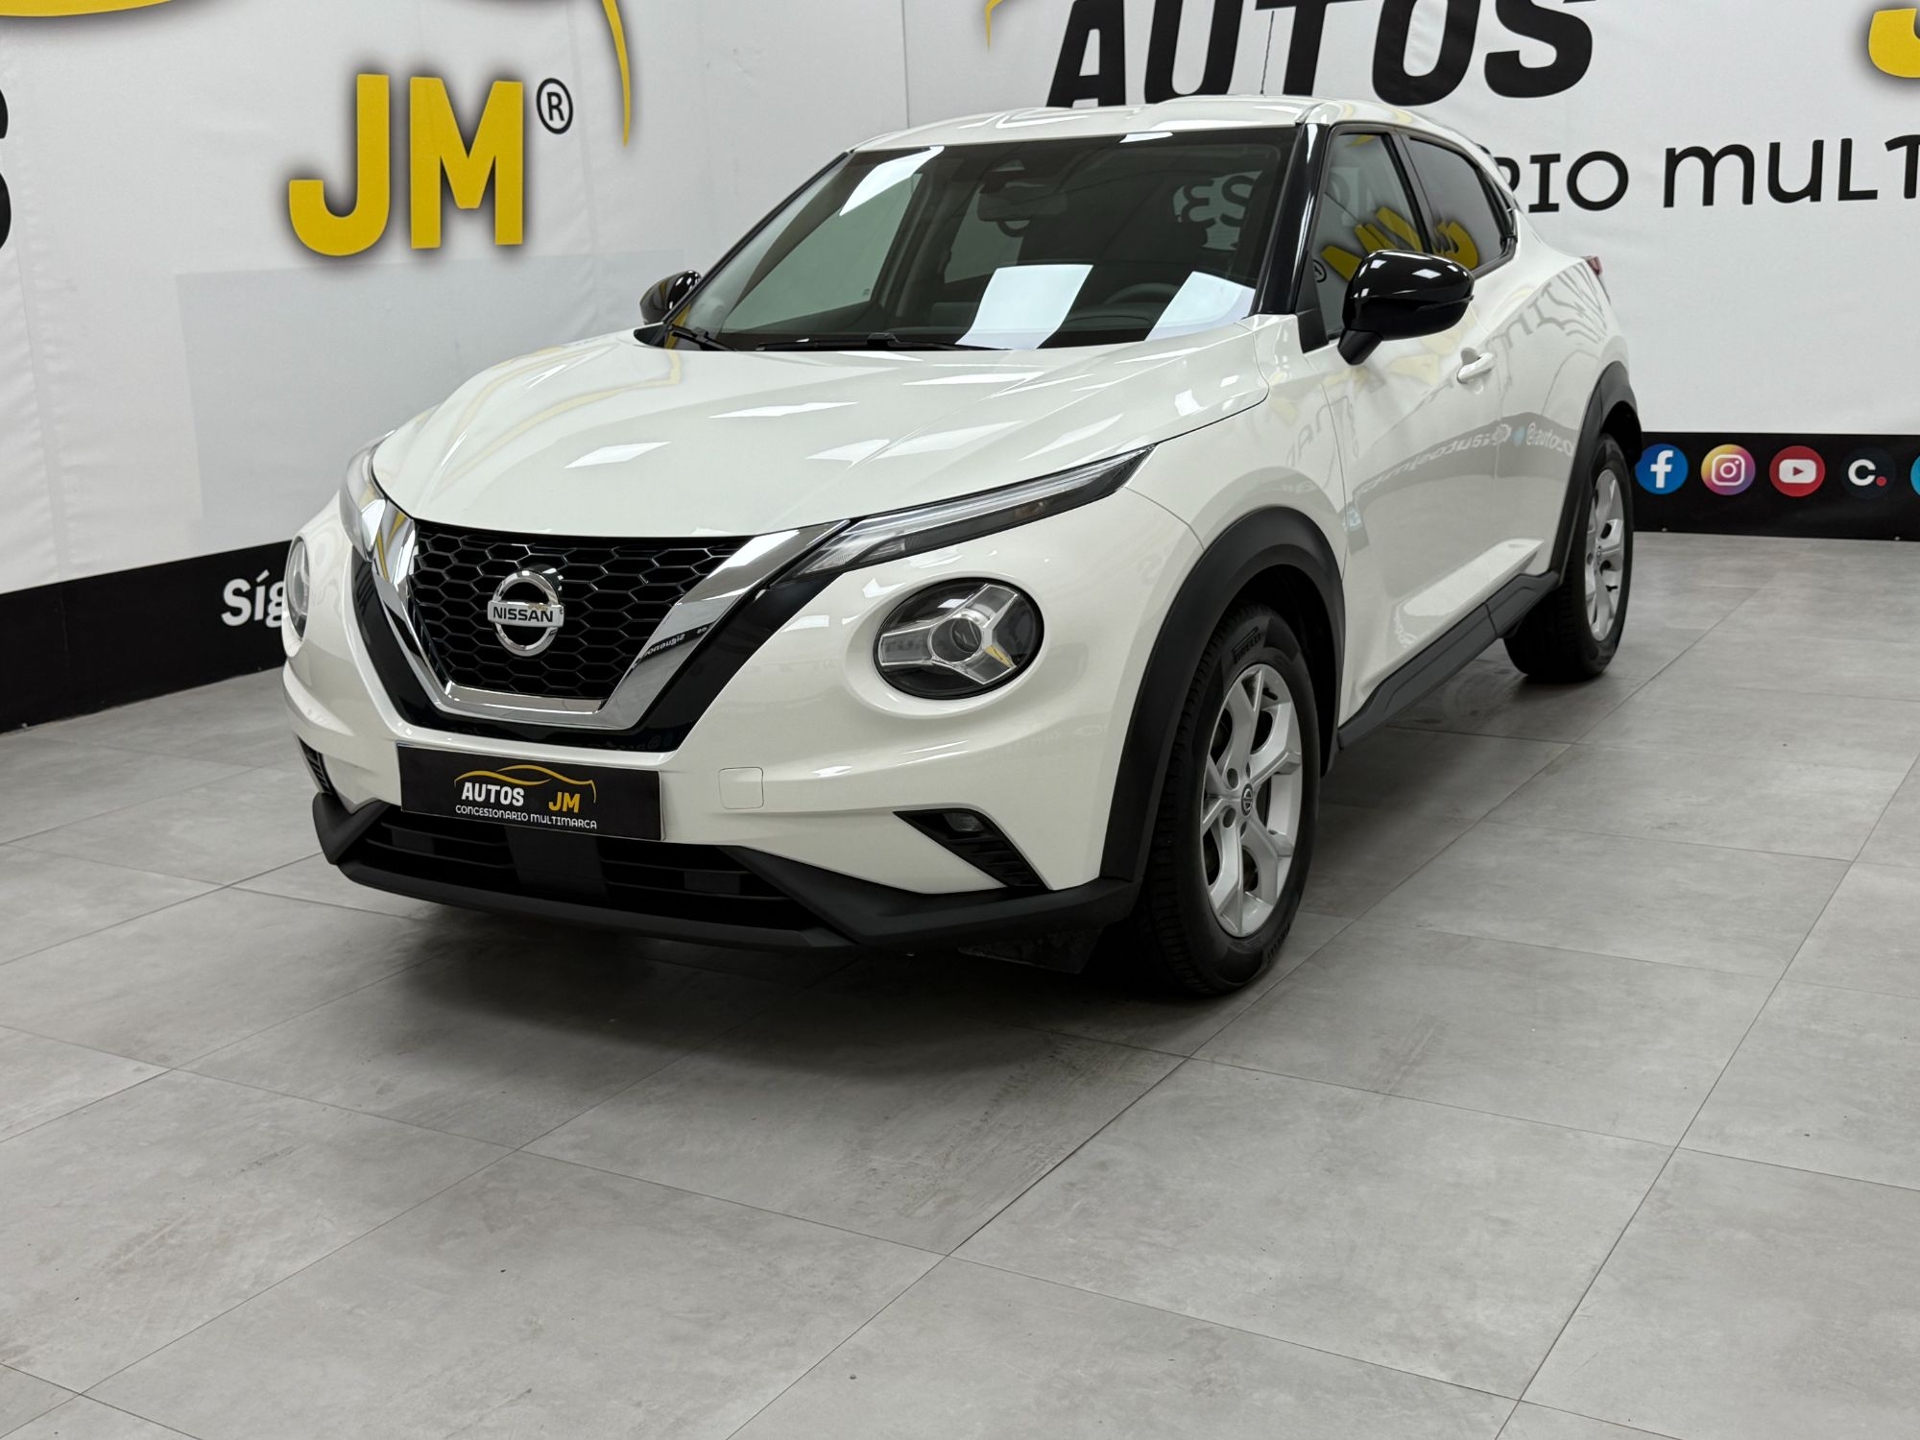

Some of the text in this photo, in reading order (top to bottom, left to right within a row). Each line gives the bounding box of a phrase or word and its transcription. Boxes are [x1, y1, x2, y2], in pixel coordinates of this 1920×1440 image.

[1046, 0, 1593, 107] AUTOS
[288, 73, 524, 256] JM
[493, 606, 554, 623] NISSAN
[461, 782, 580, 813] AUTOS JM
